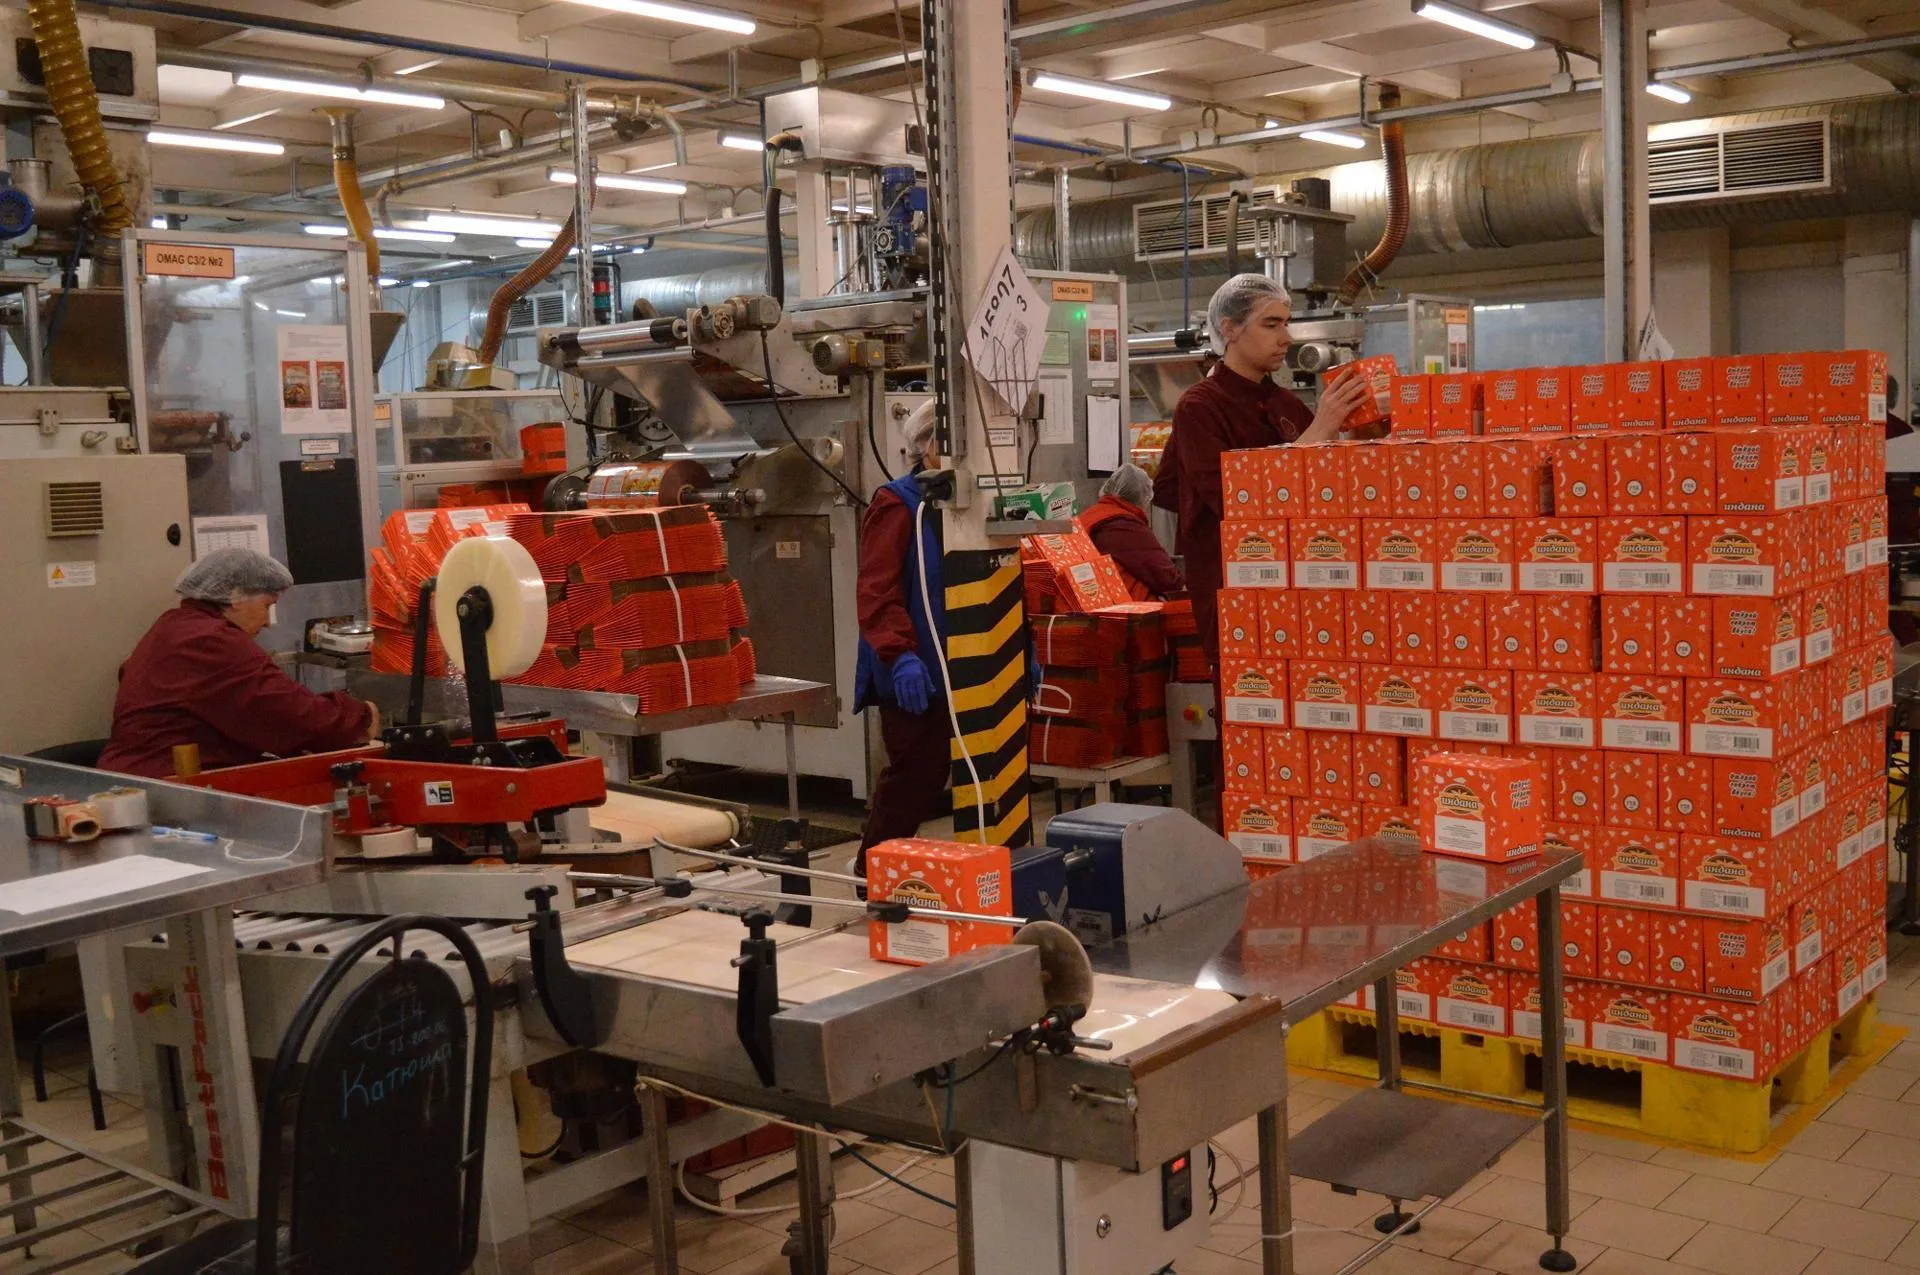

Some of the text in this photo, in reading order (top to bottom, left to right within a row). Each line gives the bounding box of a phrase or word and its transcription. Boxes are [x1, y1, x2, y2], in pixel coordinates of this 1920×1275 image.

[157, 253, 184, 264] OMAG
[1016, 295, 1028, 312] 3
[1724, 502, 1765, 511] индана
[1722, 666, 1761, 676] индана
[1711, 705, 1752, 717] индана
[1441, 797, 1478, 809] индана
[1721, 827, 1761, 838] индана
[896, 896, 939, 908] индана
[1712, 986, 1752, 997] индана
[1694, 1024, 1736, 1038] индана
